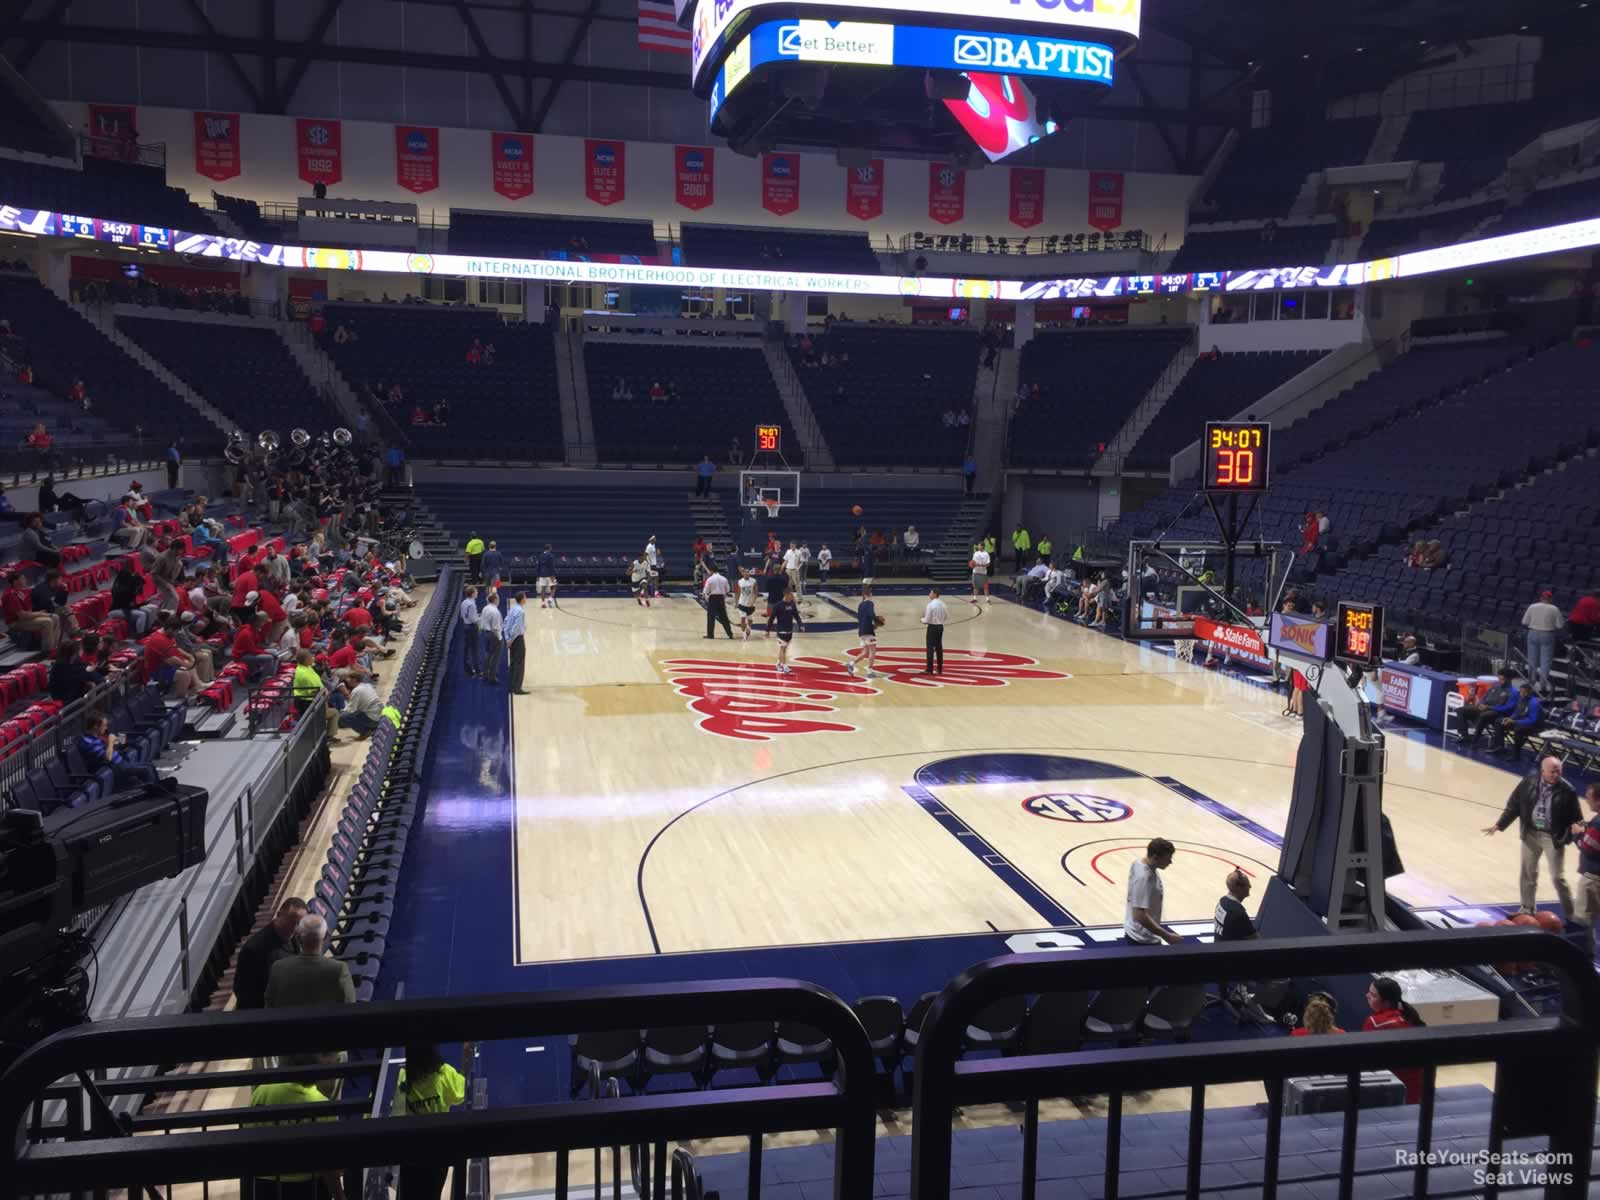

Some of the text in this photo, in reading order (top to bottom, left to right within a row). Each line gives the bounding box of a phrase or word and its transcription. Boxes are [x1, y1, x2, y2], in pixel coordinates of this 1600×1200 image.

[992, 38, 1113, 79] BAPTIST
[683, 183, 706, 196] 2001
[80, 224, 89, 234] 0
[102, 222, 132, 236] 34:07
[144, 233, 152, 243] 0
[467, 260, 871, 290] INTERNATIONAL BROTHERHOOD OF ELECTRICAL WORKERS
[760, 436, 775, 449] 30
[1212, 429, 1260, 448] 34:07
[1217, 450, 1253, 483] 30
[1346, 610, 1372, 629] 34:07
[1280, 624, 1316, 647] SONIC
[842, 646, 1074, 688] Ole
[1391, 675, 1409, 688] FARM
[657, 655, 885, 742] Miss
